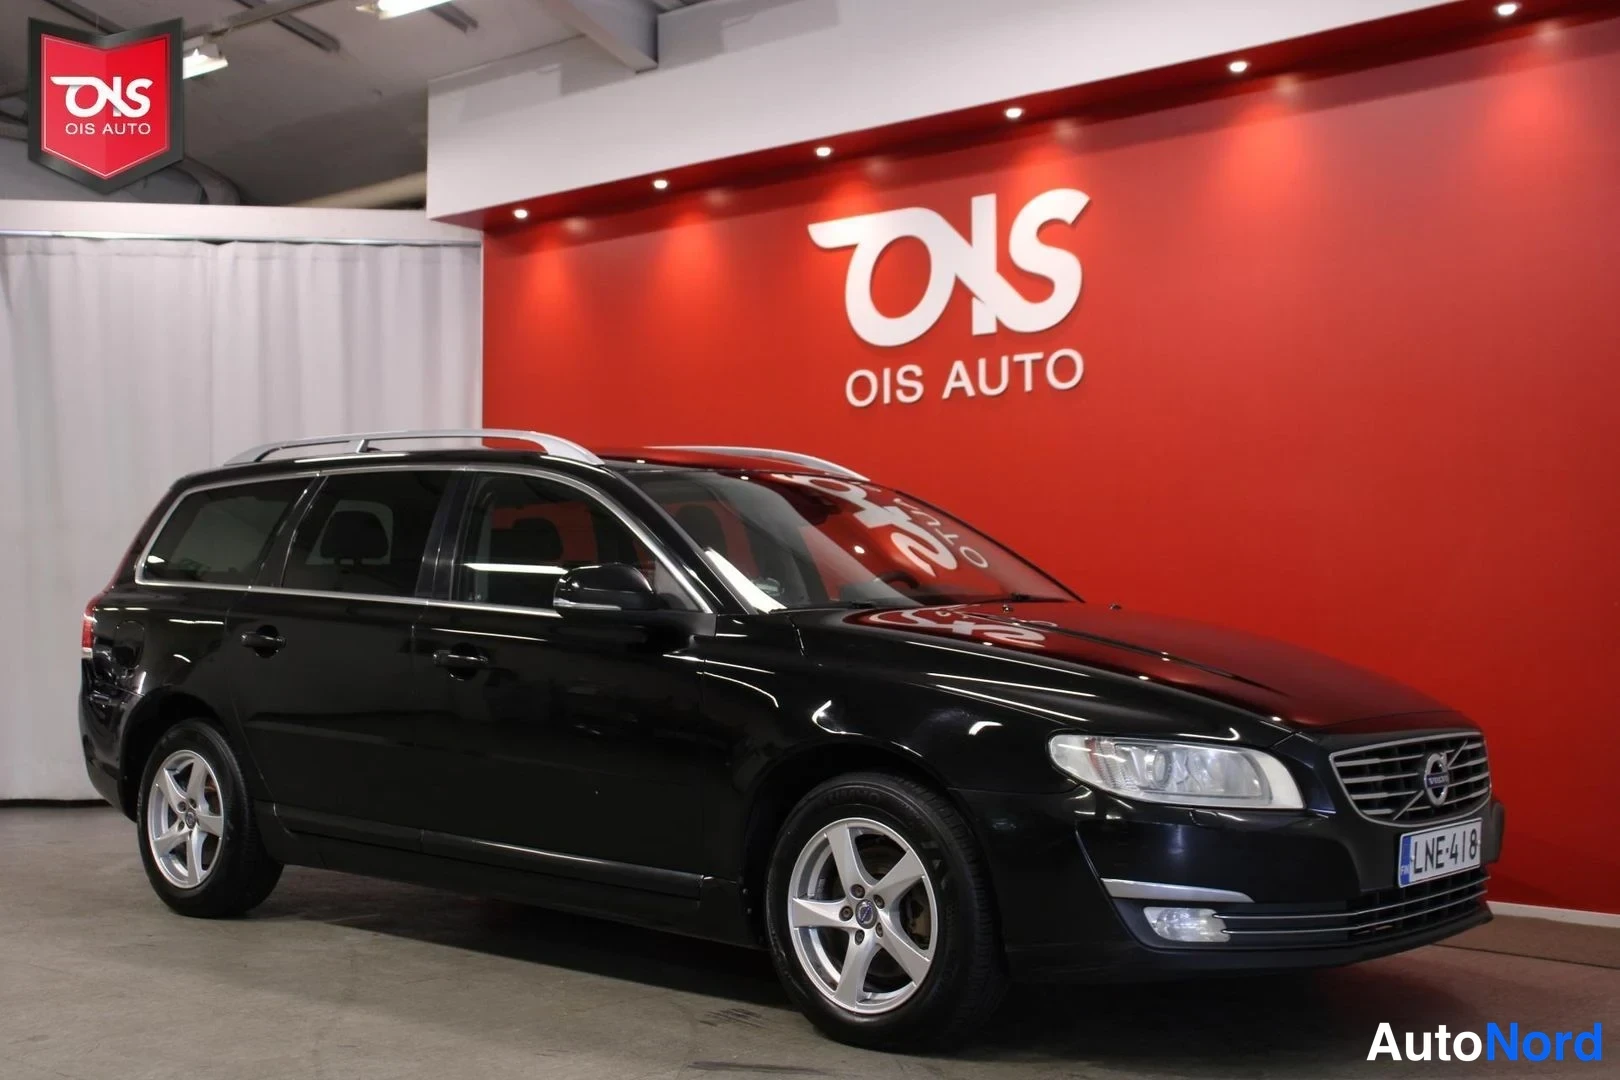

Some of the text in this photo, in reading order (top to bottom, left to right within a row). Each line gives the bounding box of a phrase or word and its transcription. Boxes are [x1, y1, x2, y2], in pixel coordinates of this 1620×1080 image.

[807, 188, 1090, 347] OIS
[845, 348, 1084, 408] OIS AUTO
[1414, 828, 1478, 875] LNE-418
